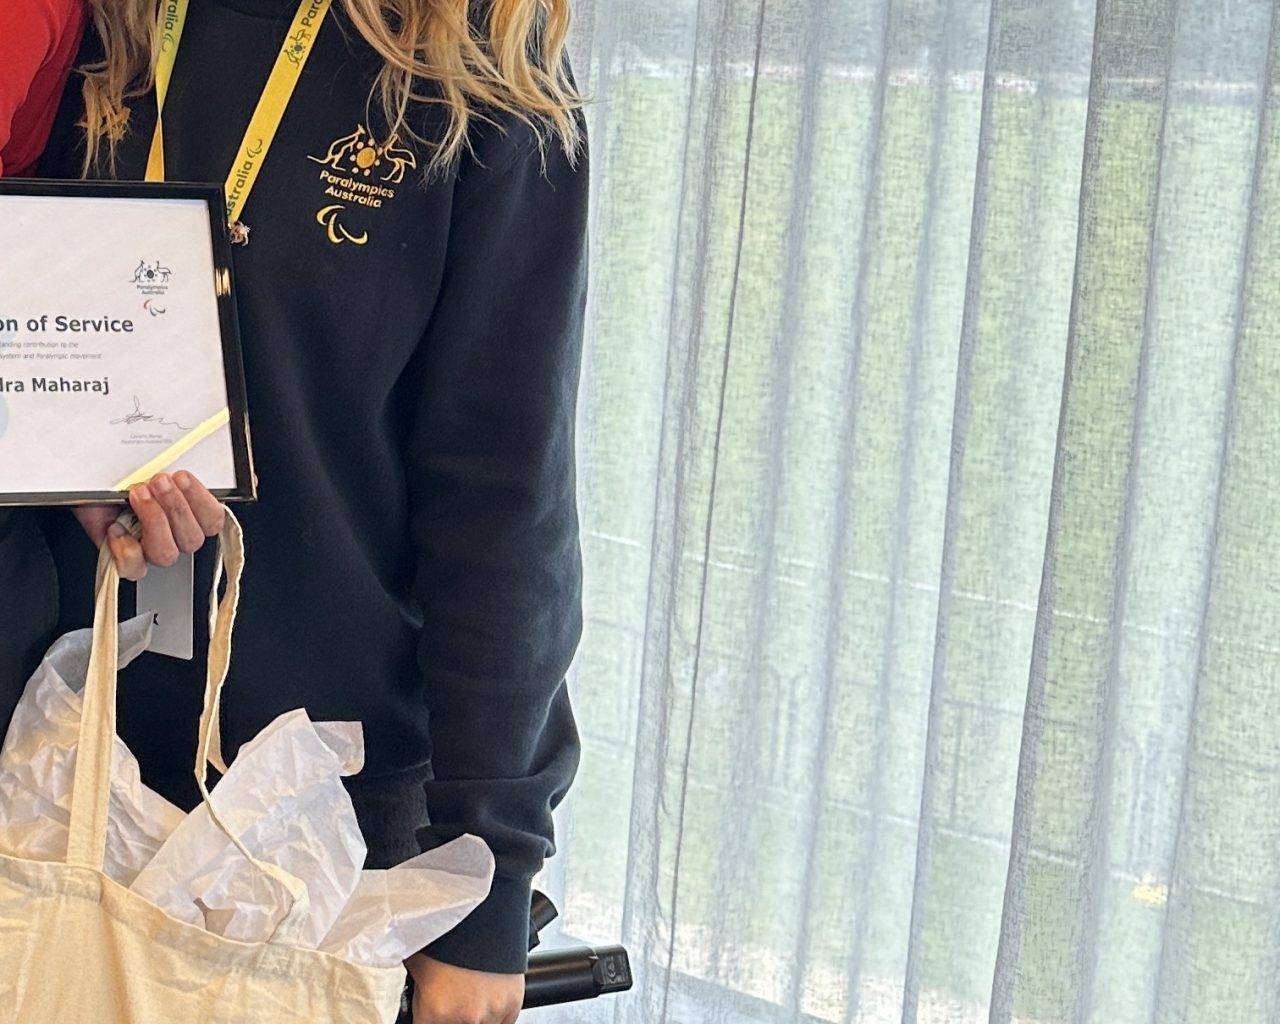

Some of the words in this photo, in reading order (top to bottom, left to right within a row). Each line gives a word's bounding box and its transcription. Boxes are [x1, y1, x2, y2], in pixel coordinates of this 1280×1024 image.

[227, 160, 253, 215] ustralia
[320, 169, 395, 198] Paralympics
[324, 185, 382, 208] Australia
[26, 314, 48, 332] of
[55, 315, 134, 332] Service
[23, 341, 59, 349] contribution
[31, 376, 109, 395] Maharaj
